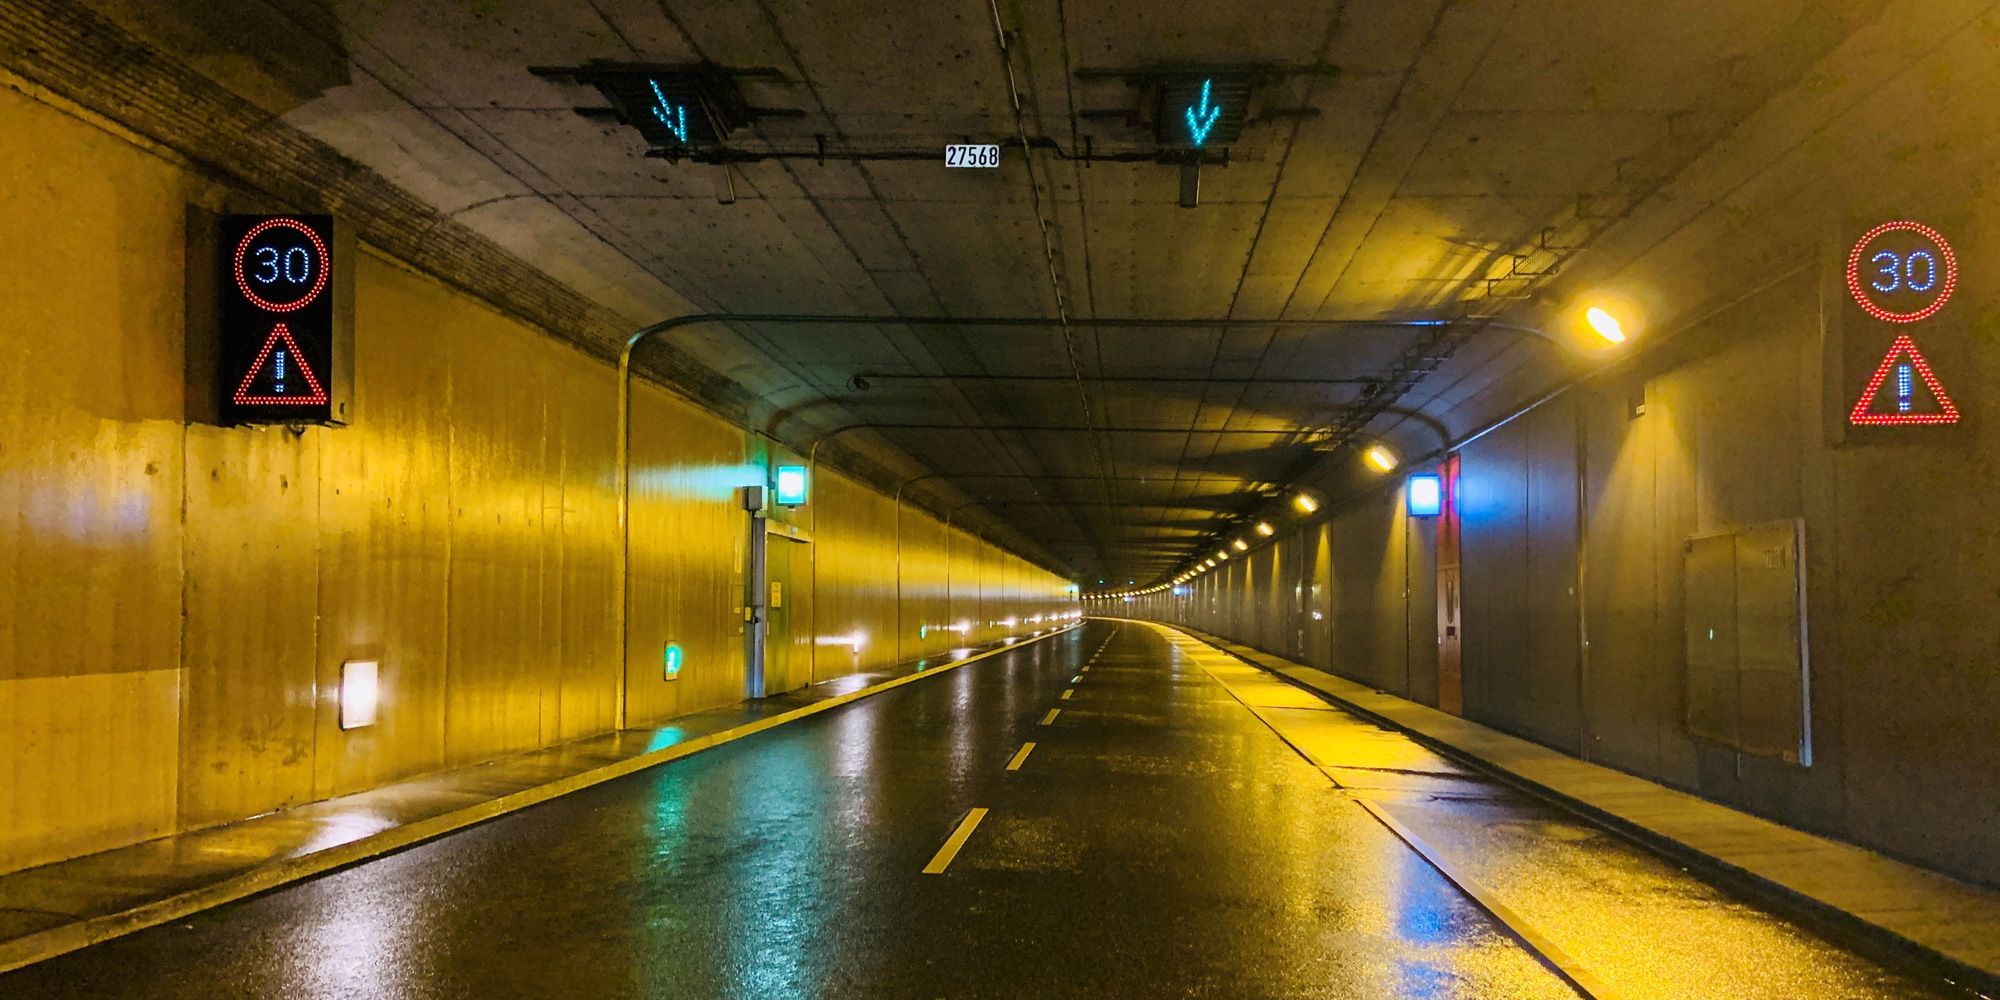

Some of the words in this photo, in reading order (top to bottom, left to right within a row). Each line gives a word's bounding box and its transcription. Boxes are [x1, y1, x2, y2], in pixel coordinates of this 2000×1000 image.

[947, 146, 998, 166] 27568
[255, 247, 309, 284] 30
[1871, 251, 1935, 292] 30
